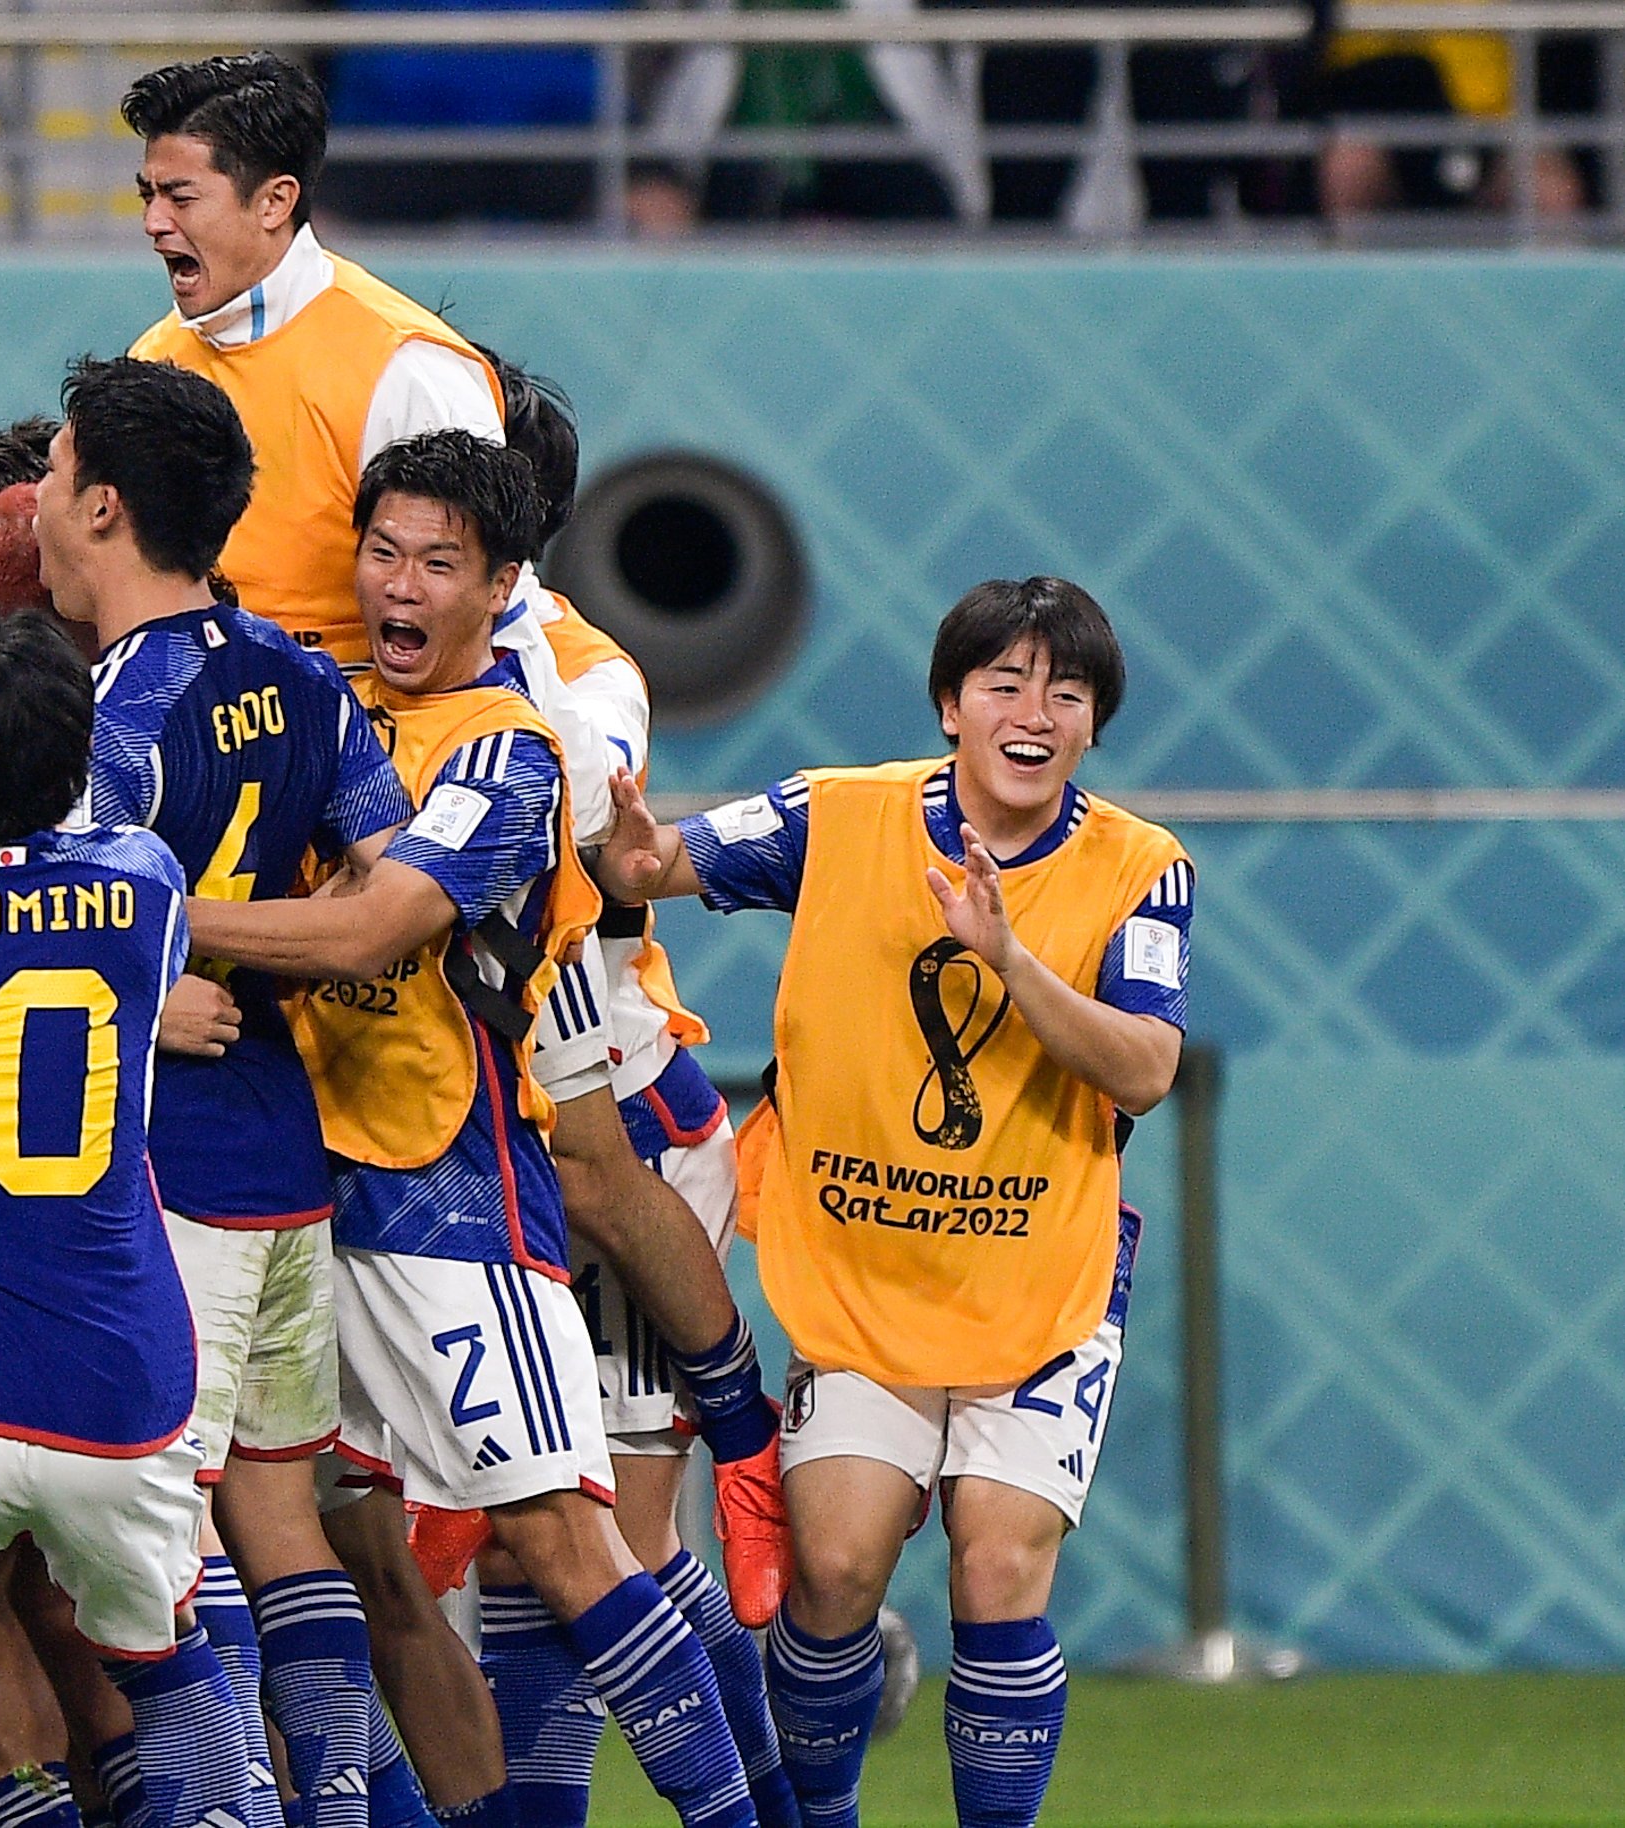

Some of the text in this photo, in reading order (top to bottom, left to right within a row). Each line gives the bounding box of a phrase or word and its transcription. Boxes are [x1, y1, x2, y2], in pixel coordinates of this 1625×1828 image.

[212, 686, 285, 754] ENDO
[811, 1150, 1049, 1202] FIFA WORLD CUP
[431, 1323, 502, 1428] 2
[1011, 1349, 1111, 1445] 24
[948, 1719, 1049, 1744] JAPAN
